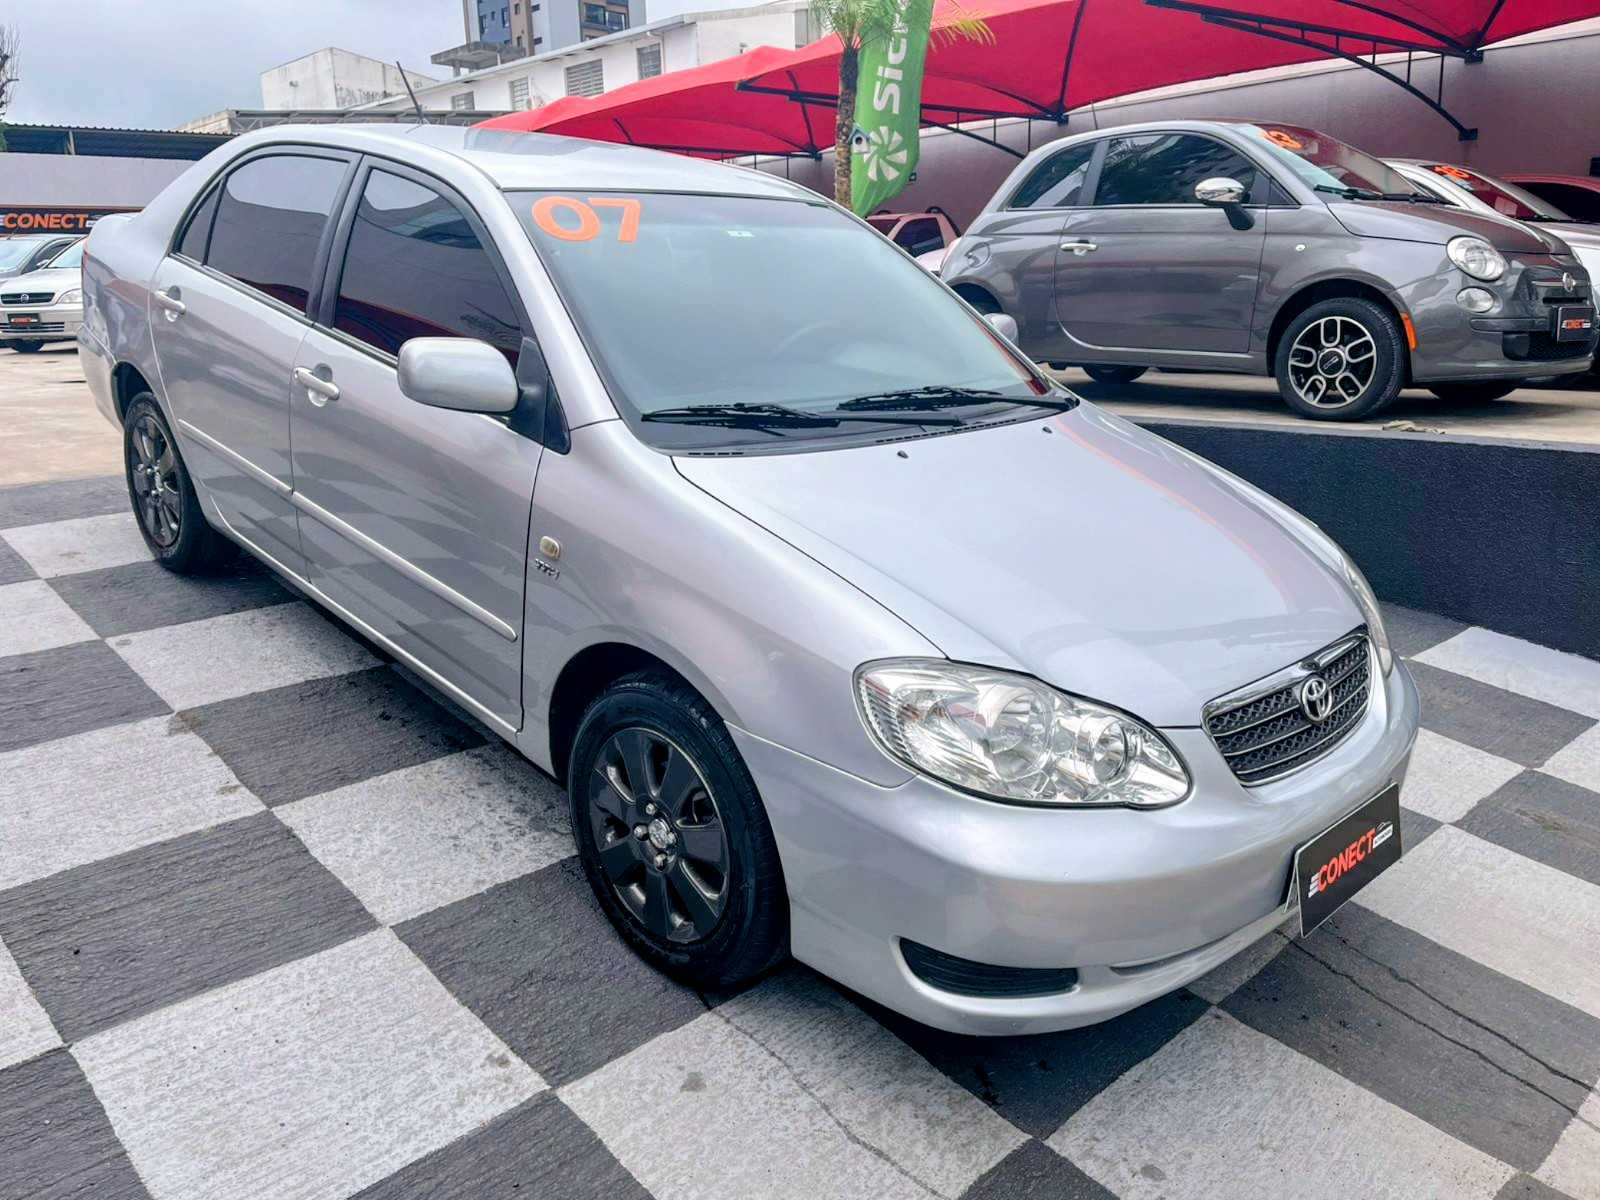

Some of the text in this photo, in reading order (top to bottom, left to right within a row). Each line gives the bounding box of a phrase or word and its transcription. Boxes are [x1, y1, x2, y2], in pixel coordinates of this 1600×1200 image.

[3, 213, 88, 228] CONECT
[531, 195, 642, 242] 07
[1317, 827, 1376, 892] CONECT
